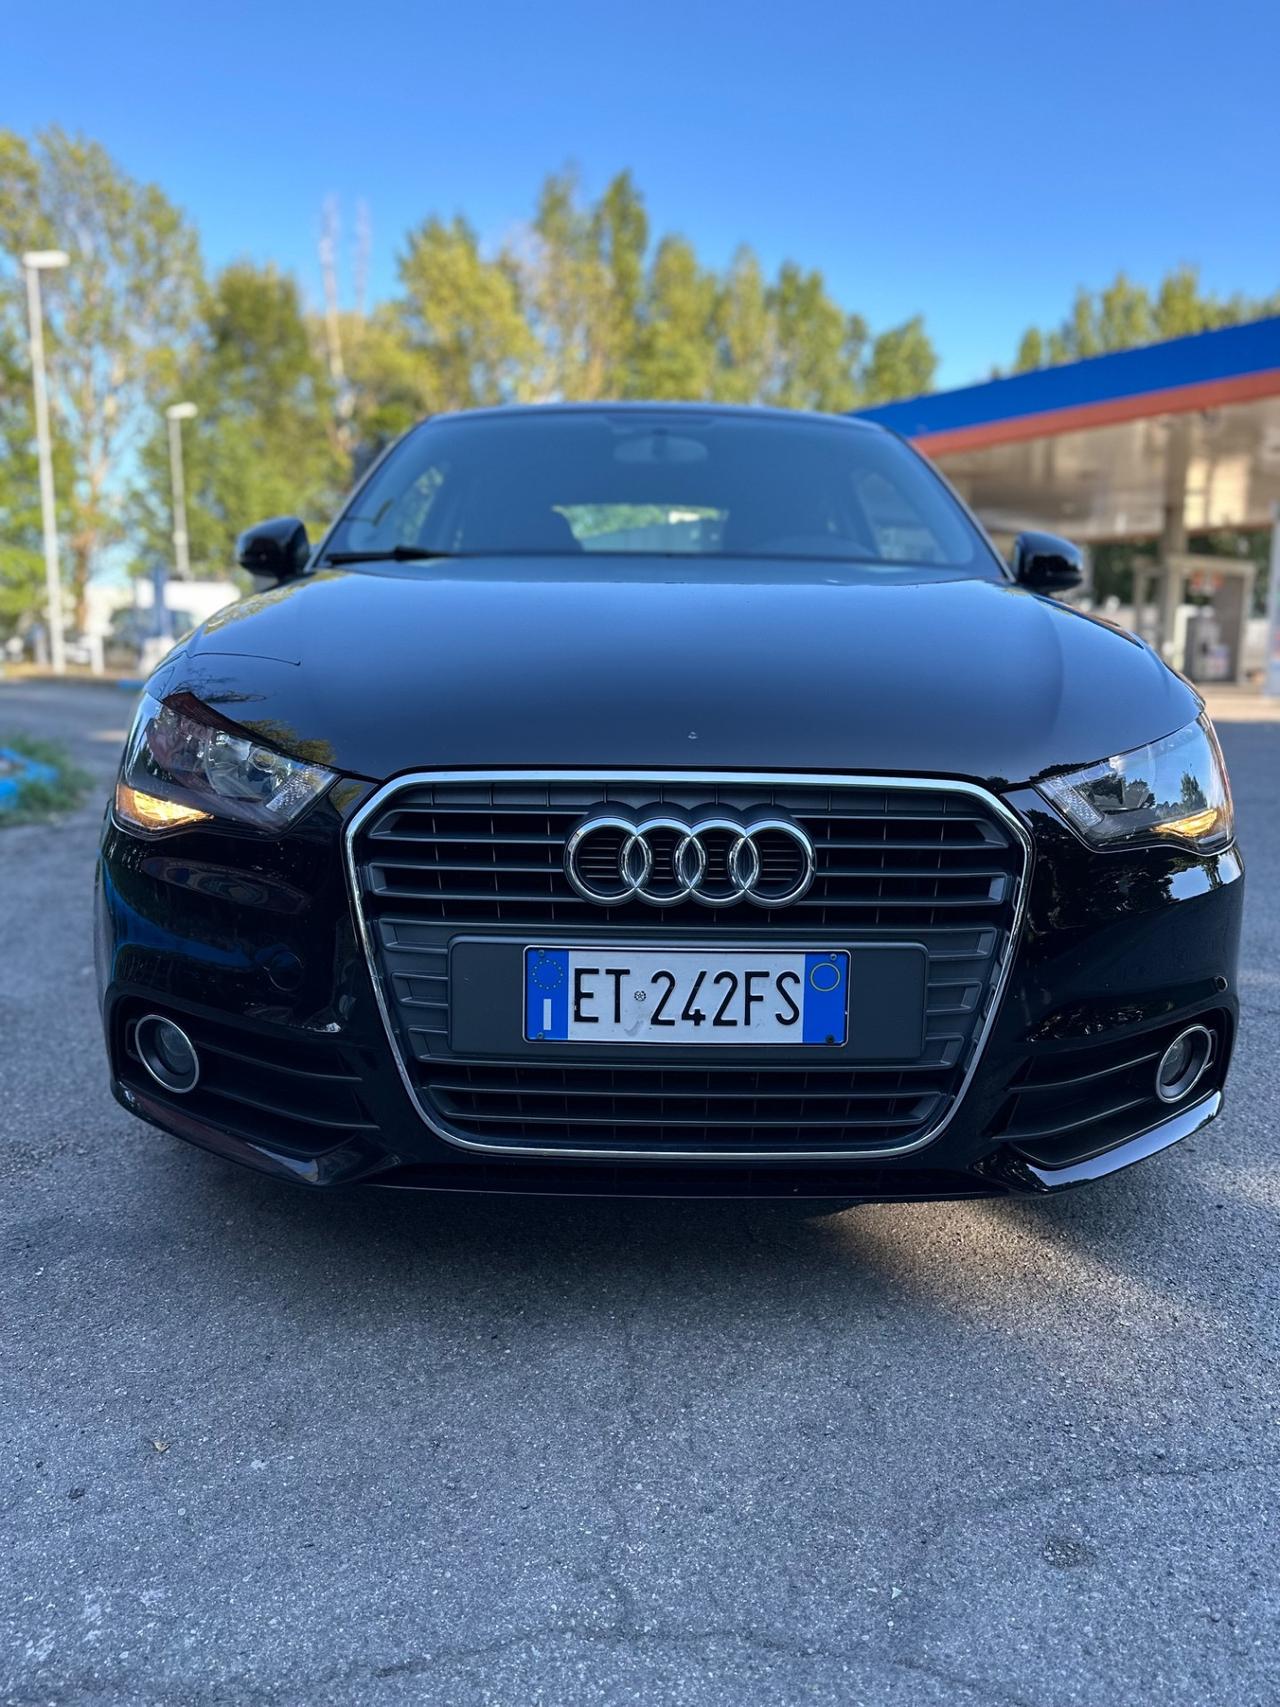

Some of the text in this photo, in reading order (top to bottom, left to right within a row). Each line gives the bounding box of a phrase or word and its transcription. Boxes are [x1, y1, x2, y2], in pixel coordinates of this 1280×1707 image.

[543, 998, 552, 1031] I
[574, 968, 800, 1026] ET 242FS
